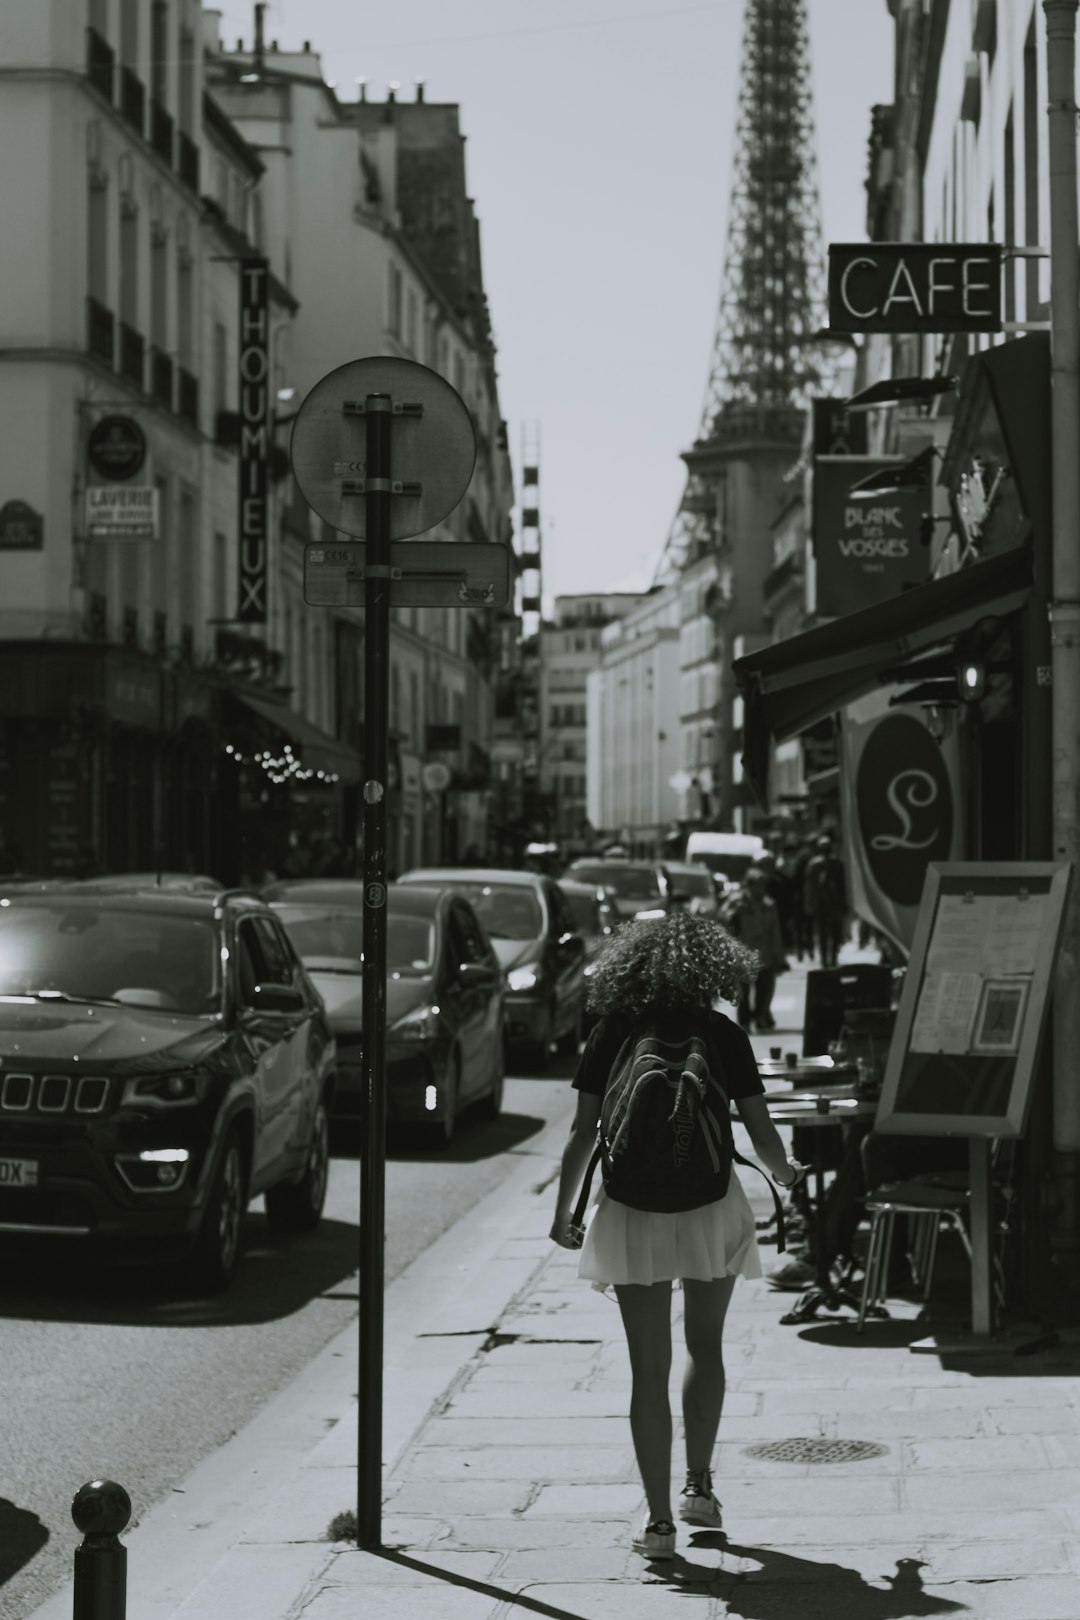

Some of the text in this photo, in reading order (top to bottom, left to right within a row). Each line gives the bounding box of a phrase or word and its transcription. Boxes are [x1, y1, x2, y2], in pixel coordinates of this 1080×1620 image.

[841, 257, 993, 318] CAFE
[240, 267, 268, 613] THOUMIEUX
[90, 490, 152, 507] LAVERIE
[844, 506, 903, 528] BLANC
[837, 538, 909, 557] VOSGES
[870, 768, 941, 850] L
